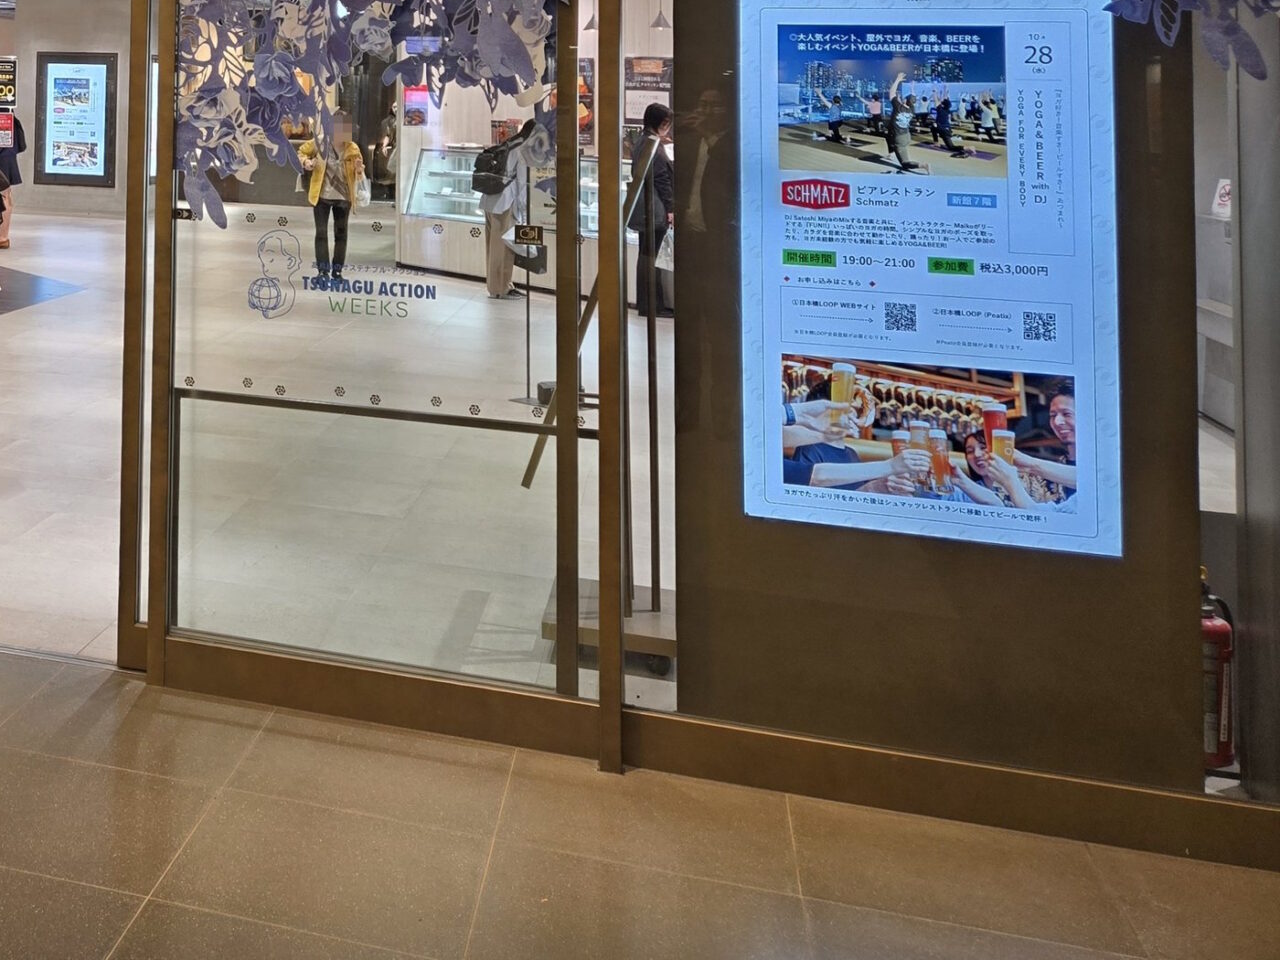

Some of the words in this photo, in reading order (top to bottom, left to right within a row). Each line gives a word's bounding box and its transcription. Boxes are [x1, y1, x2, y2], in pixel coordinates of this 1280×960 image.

[1024, 45, 1053, 65] 28
[1017, 88, 1025, 117] YOGA
[1034, 90, 1045, 180] YOGA&BEER
[856, 186, 936, 198] ビアレストラン
[1031, 182, 1050, 190] with
[786, 185, 846, 205] SCHMATZ
[1034, 195, 1047, 204] DJ
[856, 197, 899, 208] Schmatz
[786, 253, 833, 265] 開催時間
[932, 260, 969, 273] 参加費
[979, 263, 1049, 277] 税込3,000円
[302, 276, 374, 296] TSUNAGU
[378, 281, 437, 300] ACTION
[797, 276, 862, 287] お申し込みはこちら
[328, 295, 409, 318] WEEKS
